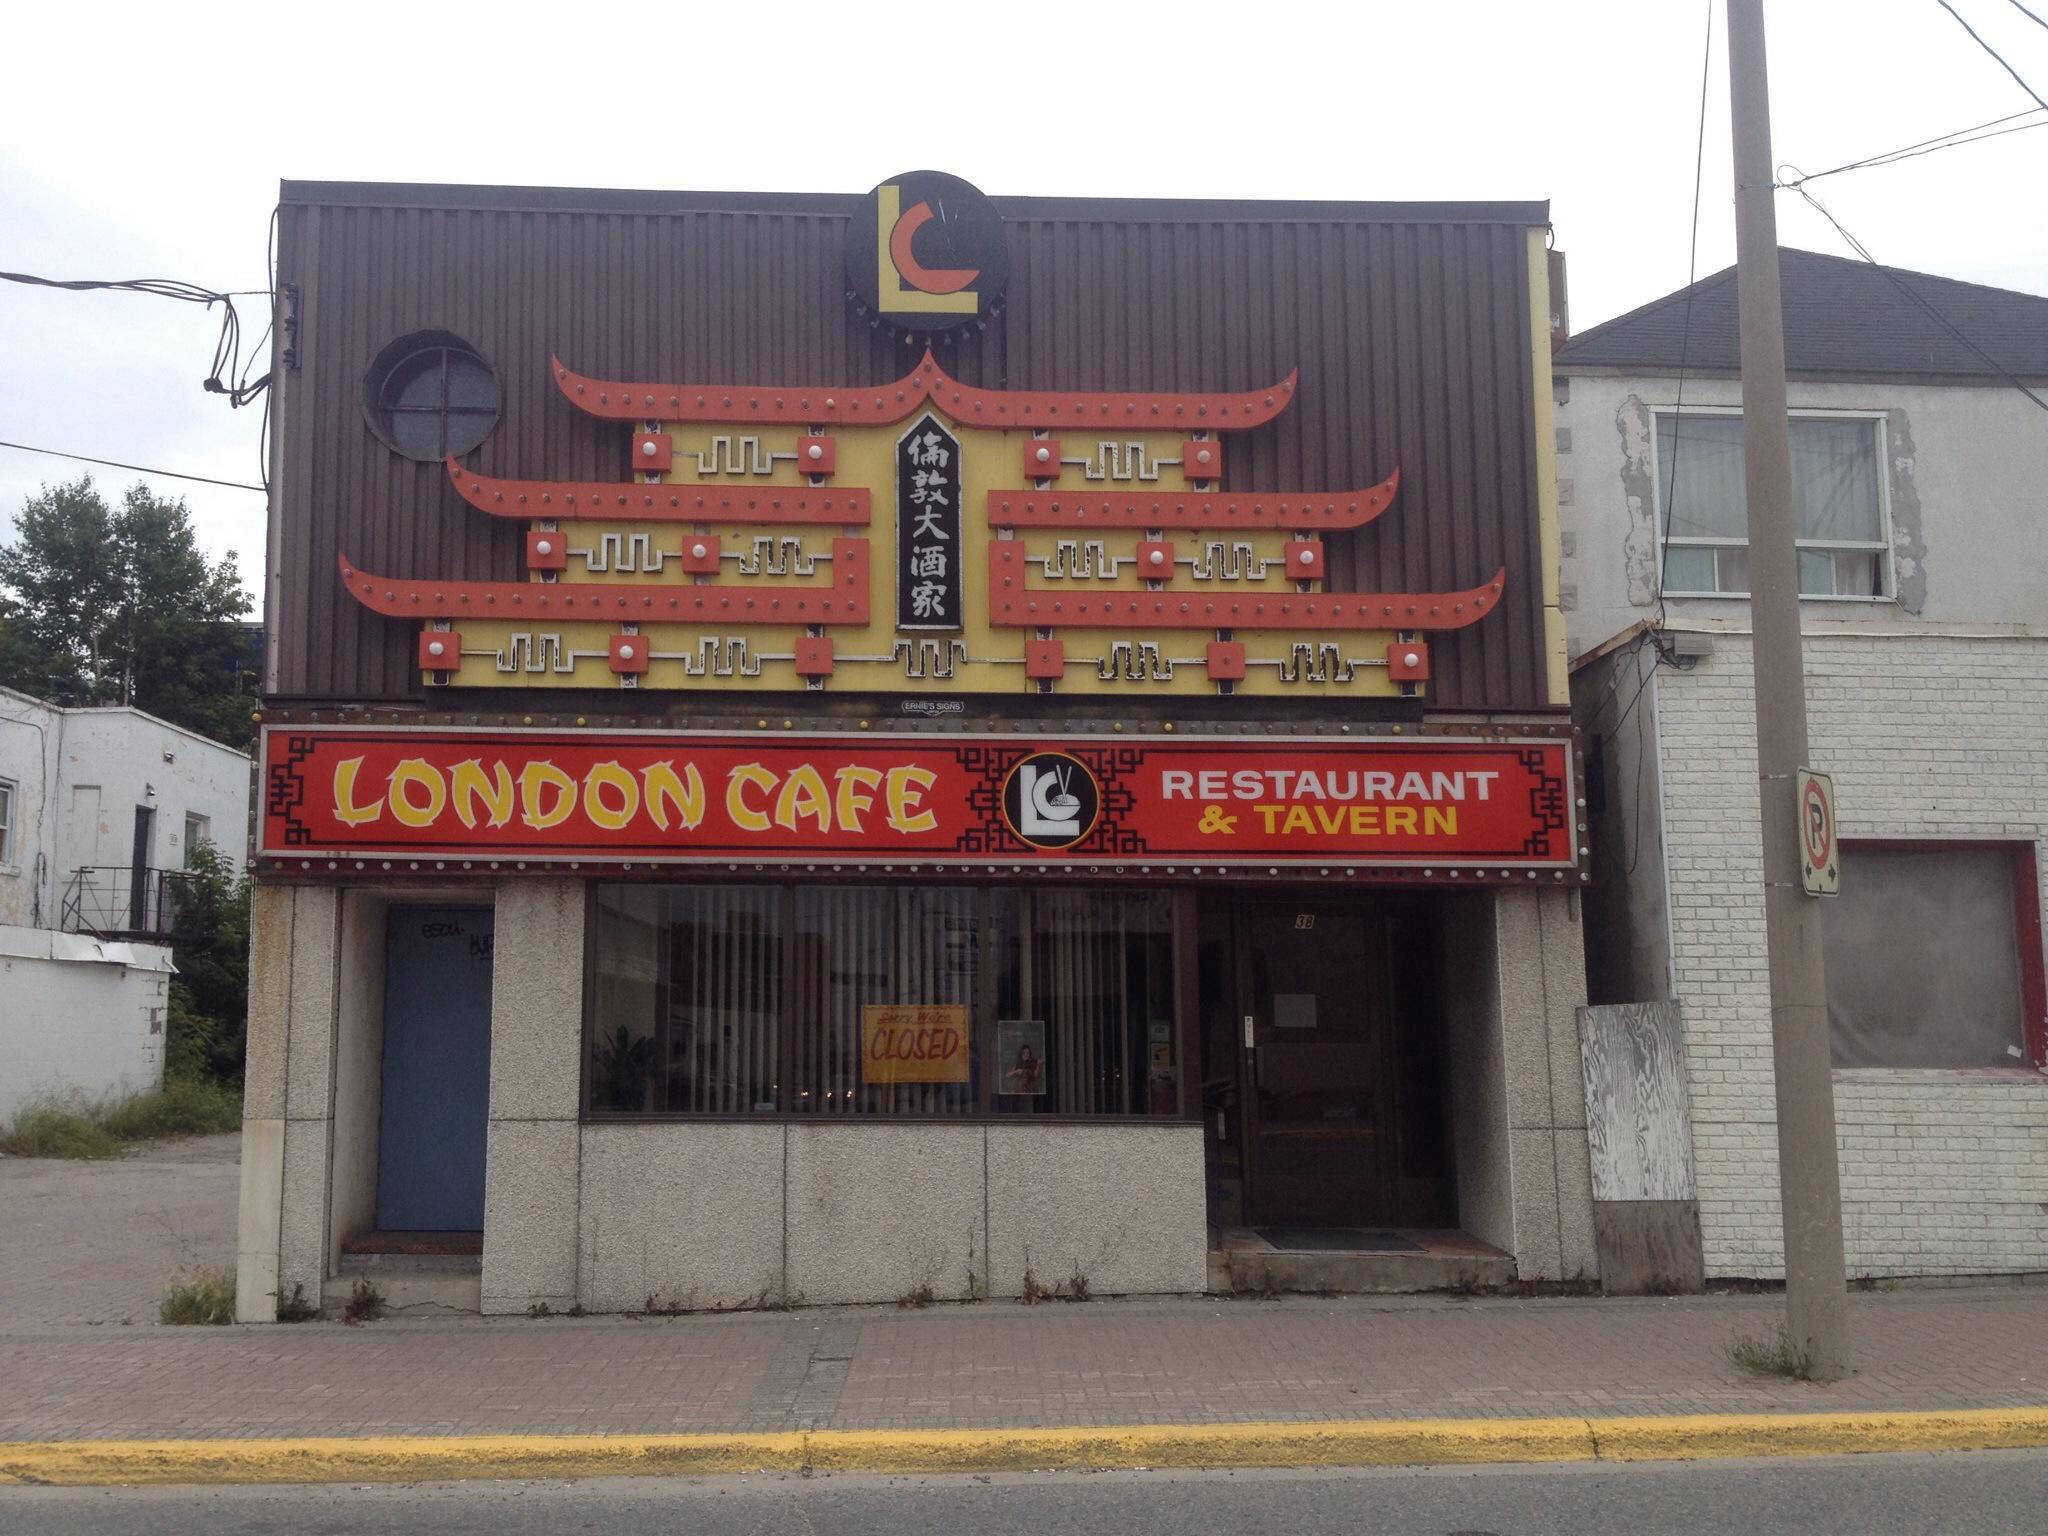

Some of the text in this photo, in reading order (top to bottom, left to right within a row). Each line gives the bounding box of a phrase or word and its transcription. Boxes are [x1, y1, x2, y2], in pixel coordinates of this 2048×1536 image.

[907, 430, 950, 618] 倫敦大酒家
[904, 702, 961, 711] ERNIE'S SIGNS
[331, 755, 938, 834] LONDON CAFE
[1161, 770, 1499, 800] RESTAURANT
[1197, 805, 1459, 835] & TAVERN
[1296, 915, 1313, 927] 38
[870, 1027, 960, 1060] CLOSED
